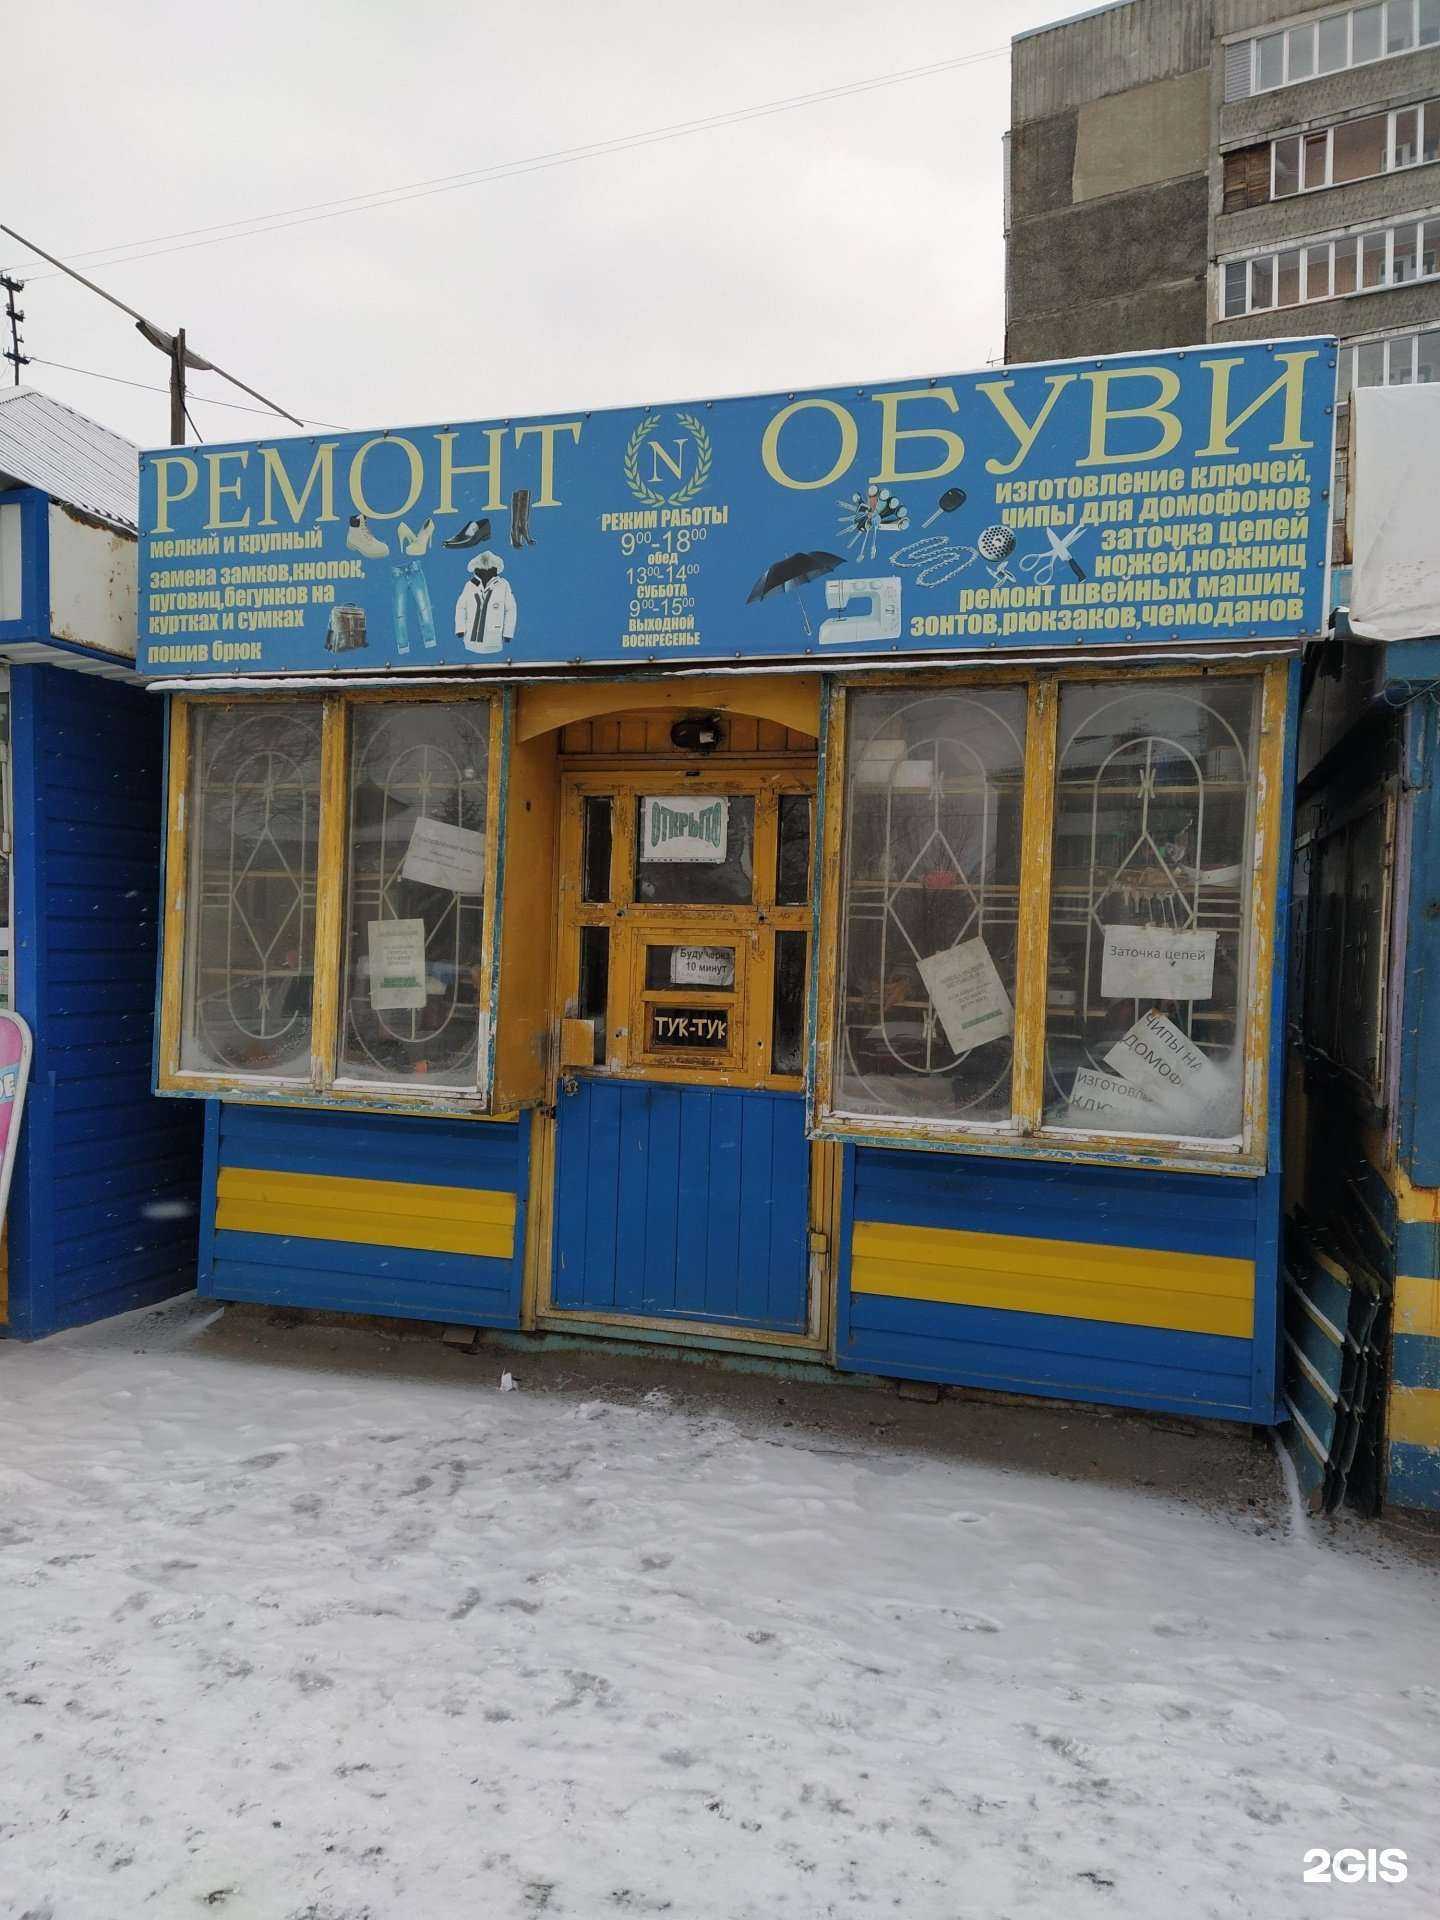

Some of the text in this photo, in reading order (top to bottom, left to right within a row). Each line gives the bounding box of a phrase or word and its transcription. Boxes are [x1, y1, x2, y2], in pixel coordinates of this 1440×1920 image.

[150, 350, 1320, 534] РЕМОНТ ОБУВИ
[648, 438, 689, 483] N
[995, 454, 1311, 504] изготовление ключей,
[601, 505, 728, 532] РЕЖИМ РАБОТЫ
[1002, 485, 1312, 529] чипы для домофонов
[149, 524, 323, 559] мелкий и крупный
[1101, 511, 1310, 552] заточка цепей
[647, 551, 679, 566] обед
[150, 567, 217, 589] замена
[636, 583, 689, 599] СУББОТА
[311, 584, 335, 603] на
[959, 571, 1306, 613] ремонт швейных машин,
[148, 609, 305, 636] куртках и сумках
[628, 614, 696, 633] ВЫХОДНОЙ
[148, 640, 262, 664] пошив брюк
[621, 632, 701, 648] ВОСКРЕСЕНЬЕ
[651, 801, 722, 848] ОТКРЫТО
[1111, 945, 1206, 963] Заточка цепей
[686, 961, 728, 976] 10 минут
[654, 1016, 727, 1040] ТУК-ТУК
[1145, 1013, 1185, 1054] ЧИПЫ
[1121, 1034, 1184, 1088] ДОМОФ
